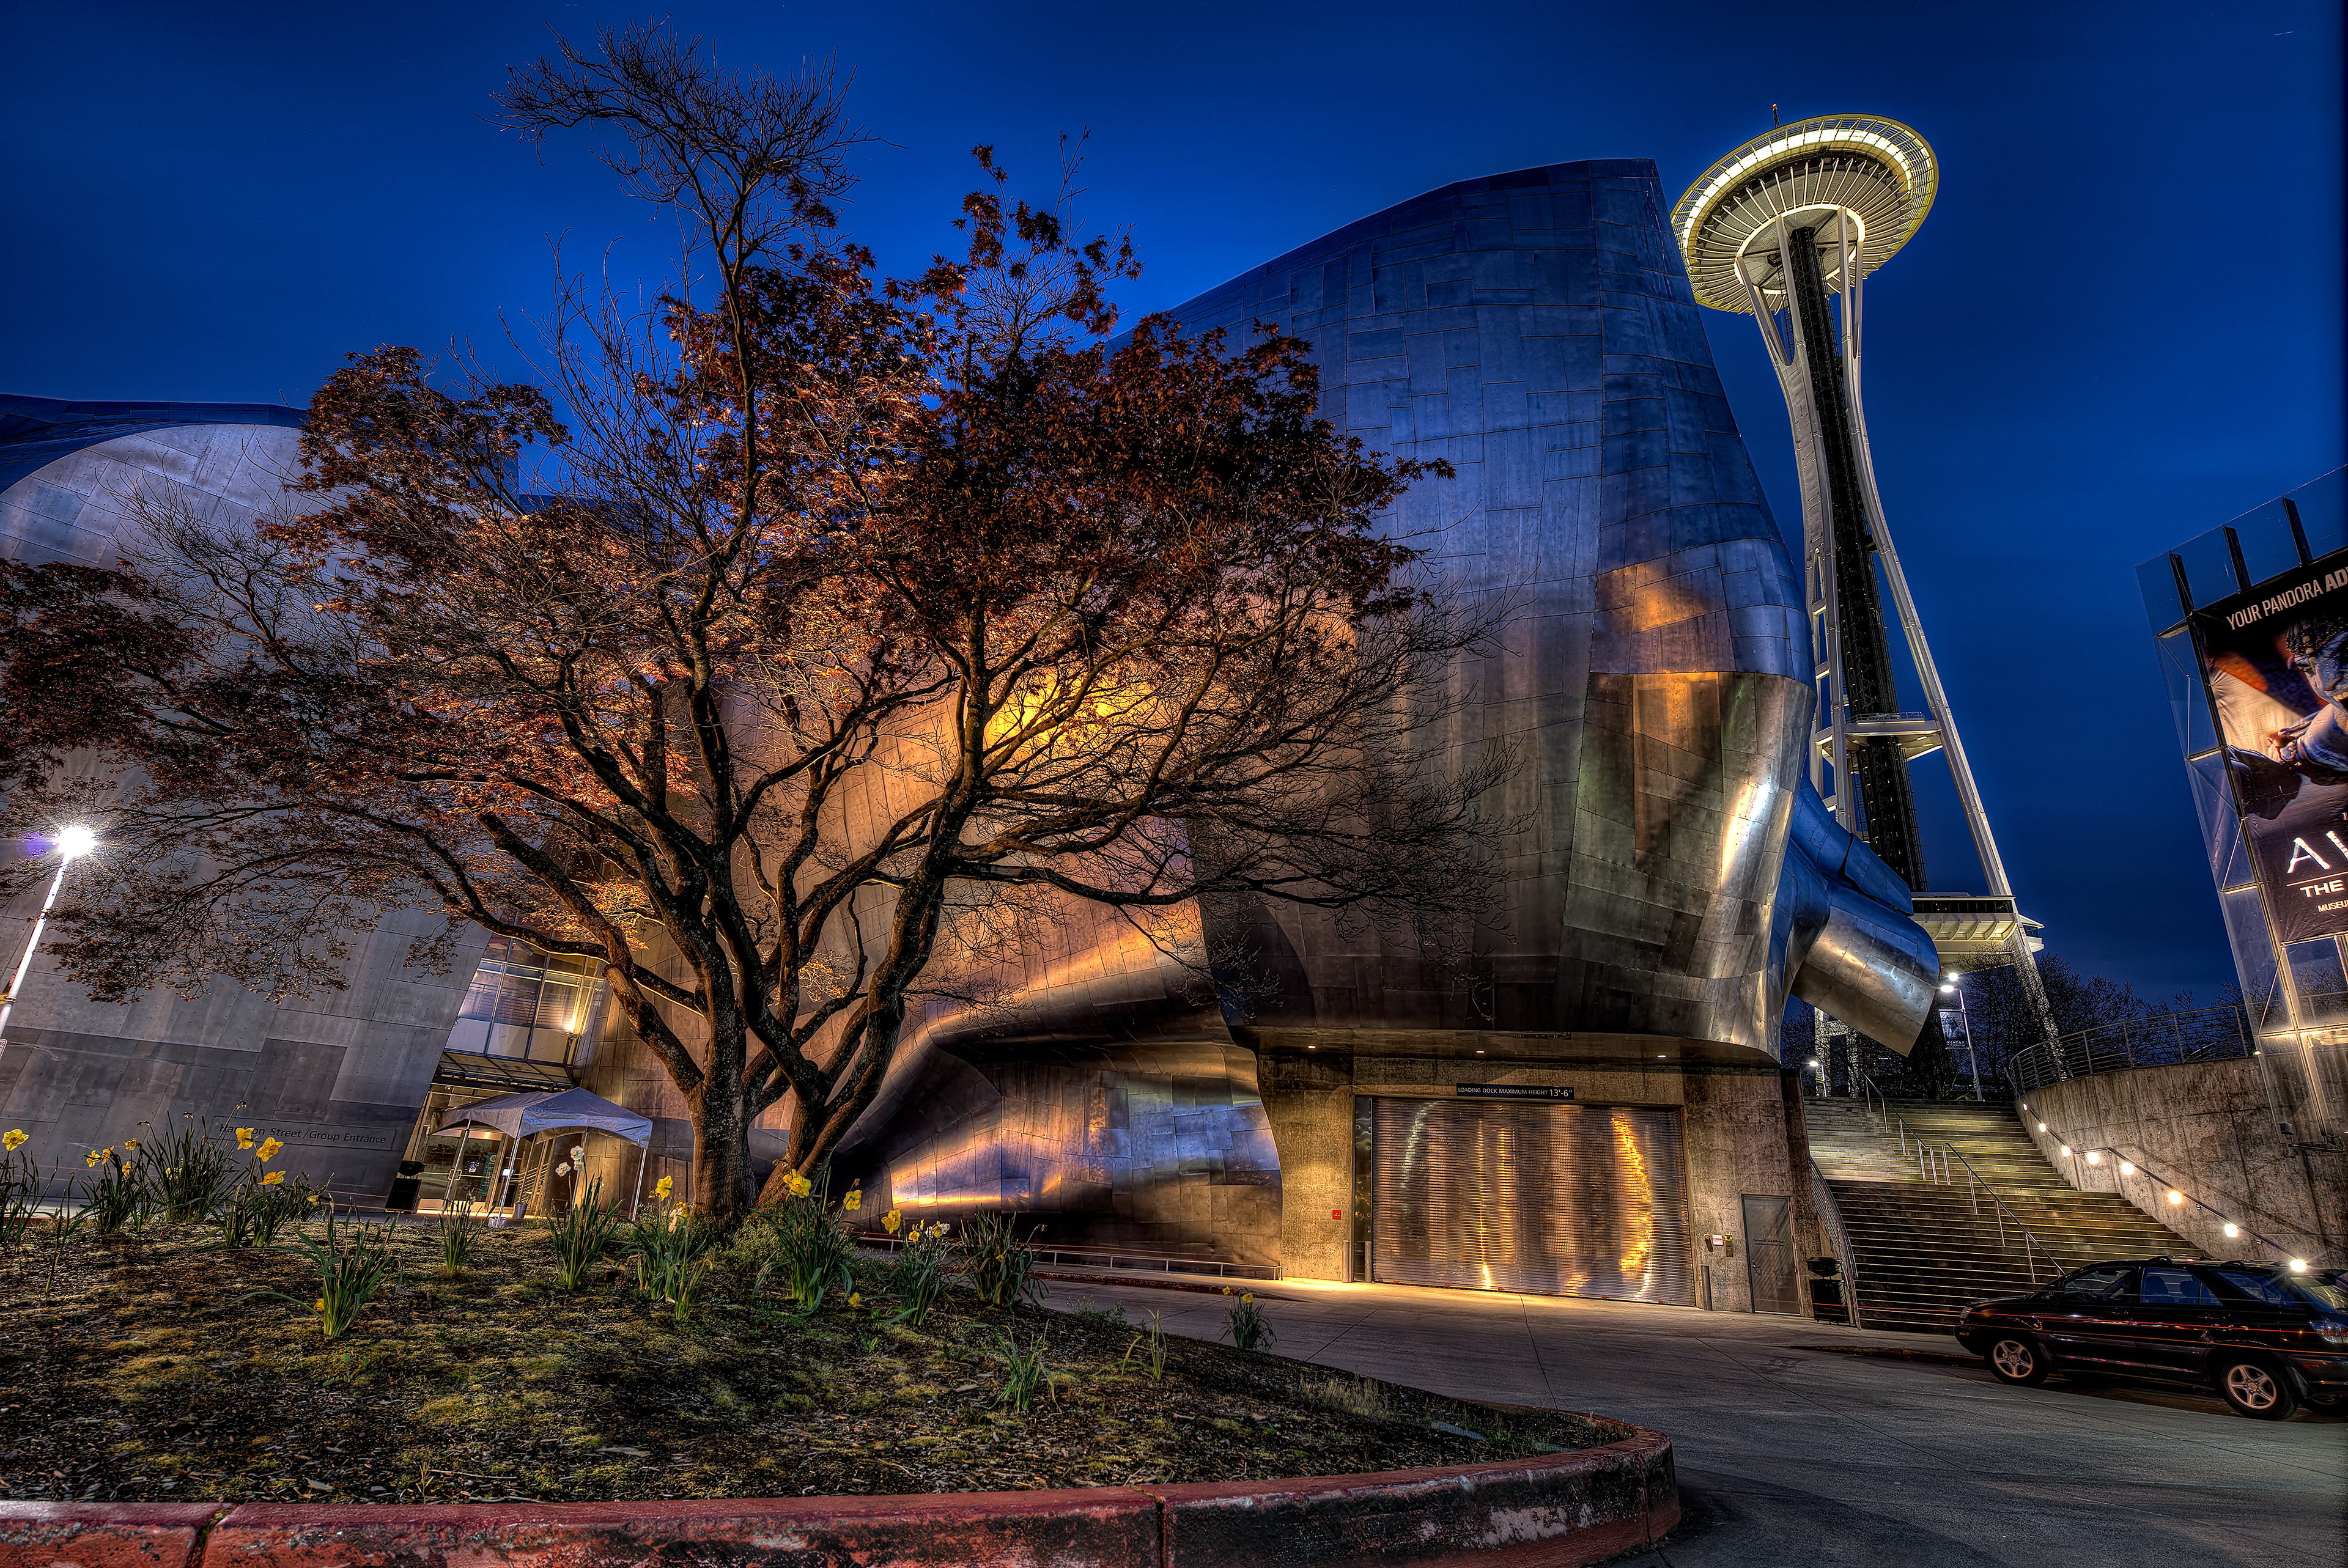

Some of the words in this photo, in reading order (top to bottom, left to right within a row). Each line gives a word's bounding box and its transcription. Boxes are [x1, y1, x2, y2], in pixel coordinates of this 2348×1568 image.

[2226, 604, 2262, 630] YOUR
[2262, 580, 2324, 617] PANDORA
[2325, 567, 2348, 592] AD
[2300, 879, 2346, 897] THE
[2317, 899, 2348, 913] MUSEU
[1549, 1089, 1573, 1097] 13'-6"
[220, 1124, 265, 1135] Haron
[344, 1133, 386, 1144] Entrance
